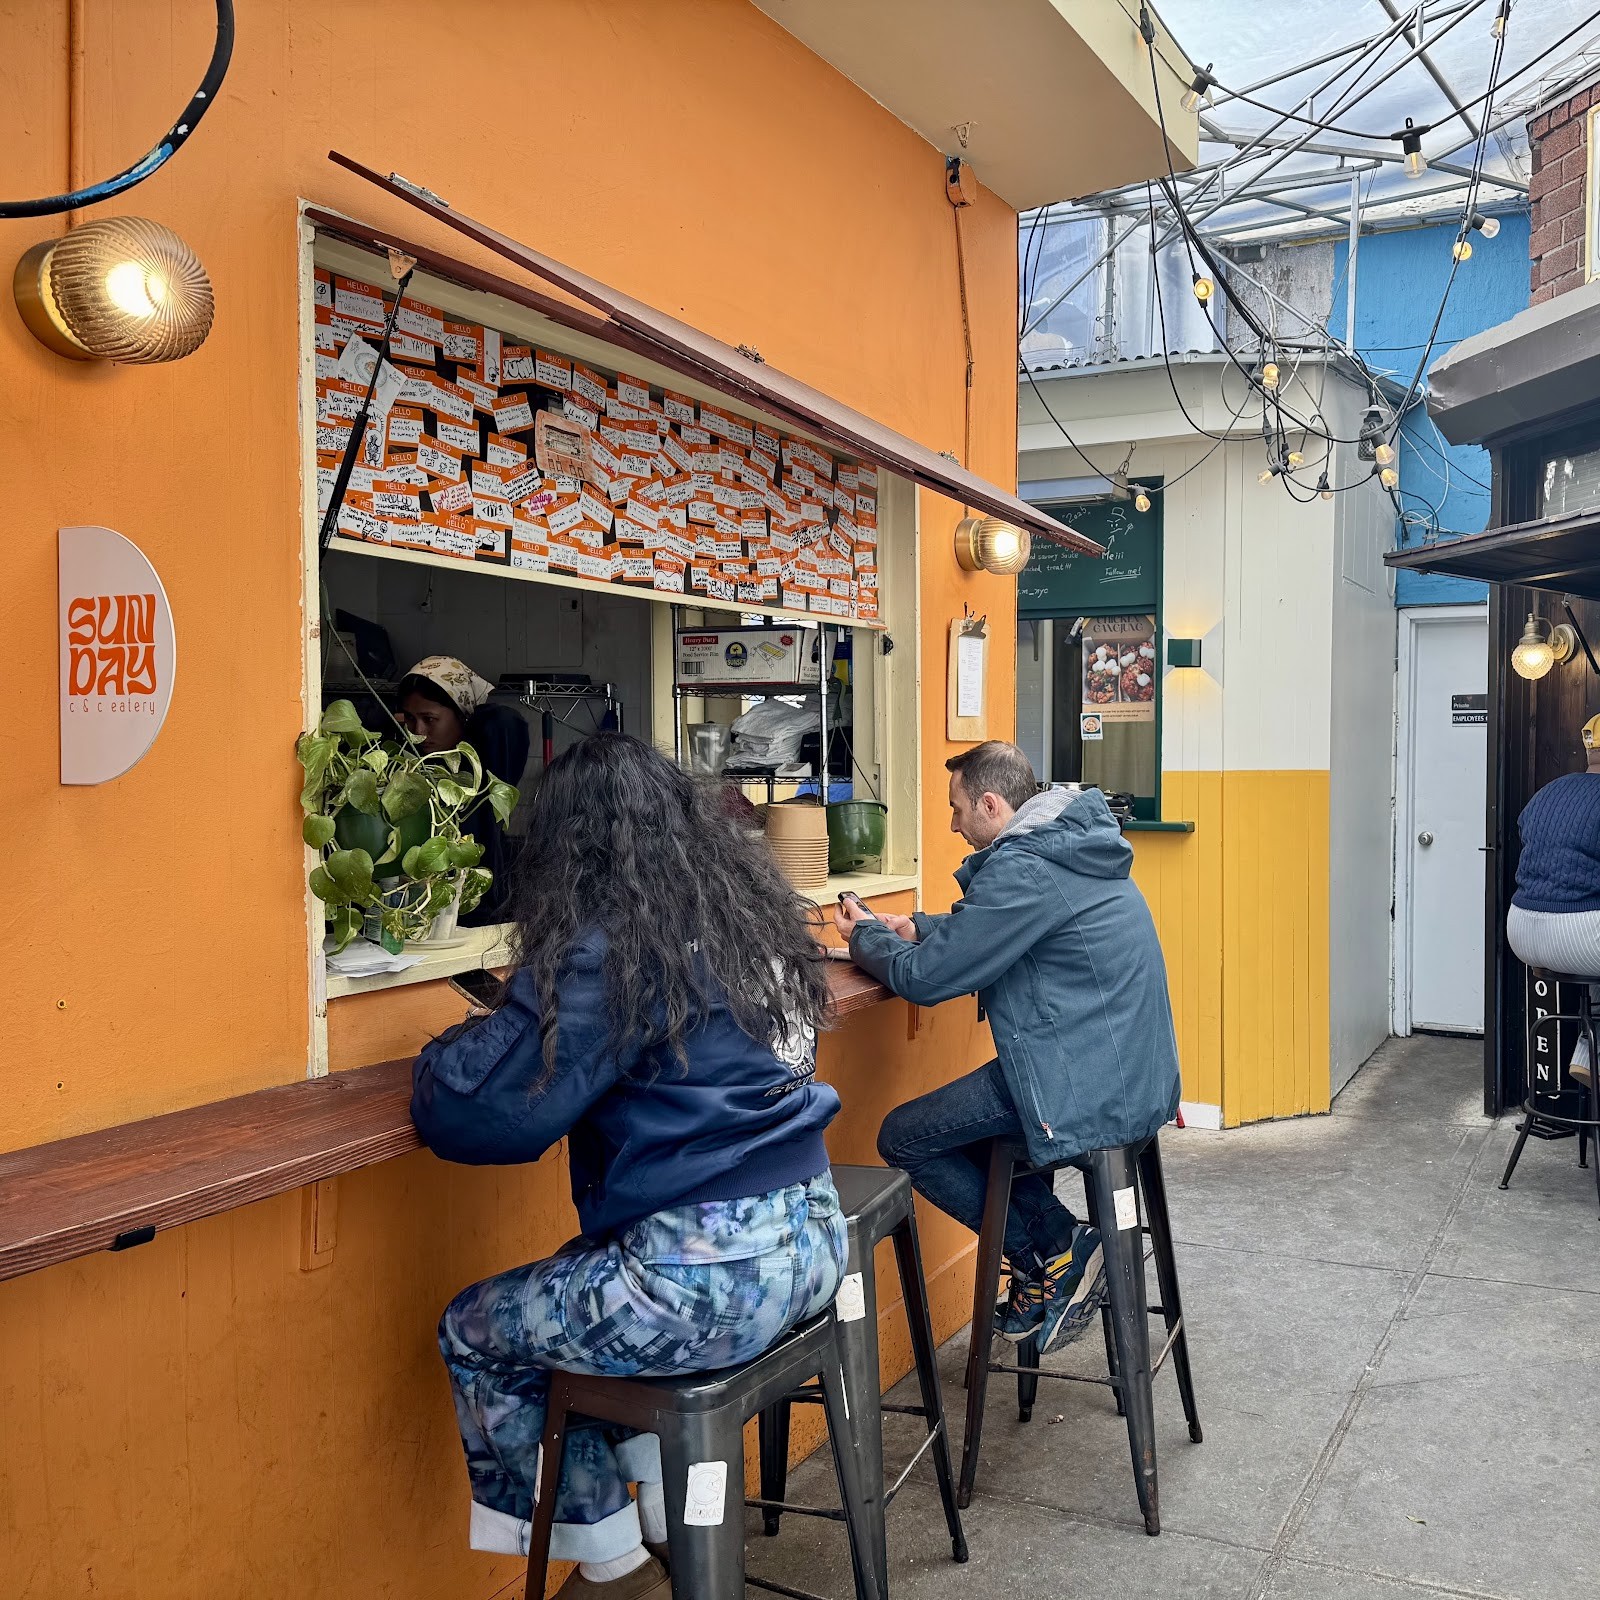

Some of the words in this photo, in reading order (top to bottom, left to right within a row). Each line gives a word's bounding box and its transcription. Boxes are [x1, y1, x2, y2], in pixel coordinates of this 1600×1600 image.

[346, 280, 370, 292] HELLO
[410, 300, 432, 313] HELLO
[450, 324, 472, 334] HELLO
[545, 355, 562, 364] HELLO
[404, 367, 425, 377] HELLO
[340, 381, 364, 392] HELLO
[444, 382, 464, 395] HELLO
[330, 392, 342, 403] You
[433, 396, 446, 408] FED
[501, 396, 518, 405] HELLO
[390, 408, 411, 416] HELLO
[432, 438, 451, 452] HELLO
[499, 438, 517, 448] HELLO
[391, 454, 412, 462] HELLO
[483, 464, 502, 473] HELLO
[509, 464, 526, 475] HELLO
[591, 490, 606, 503] HELLO
[637, 494, 651, 506] HELLO
[553, 497, 568, 508] HELLO
[446, 520, 465, 529] HELLO
[522, 542, 540, 551] HELLO
[1105, 567, 1125, 576] Follow
[1127, 566, 1142, 575] me!
[68, 594, 156, 646] SUN
[1093, 623, 1143, 633] GANGJUNG
[69, 645, 156, 695] DAY
[83, 698, 89, 712] &
[111, 698, 155, 715] eatery
